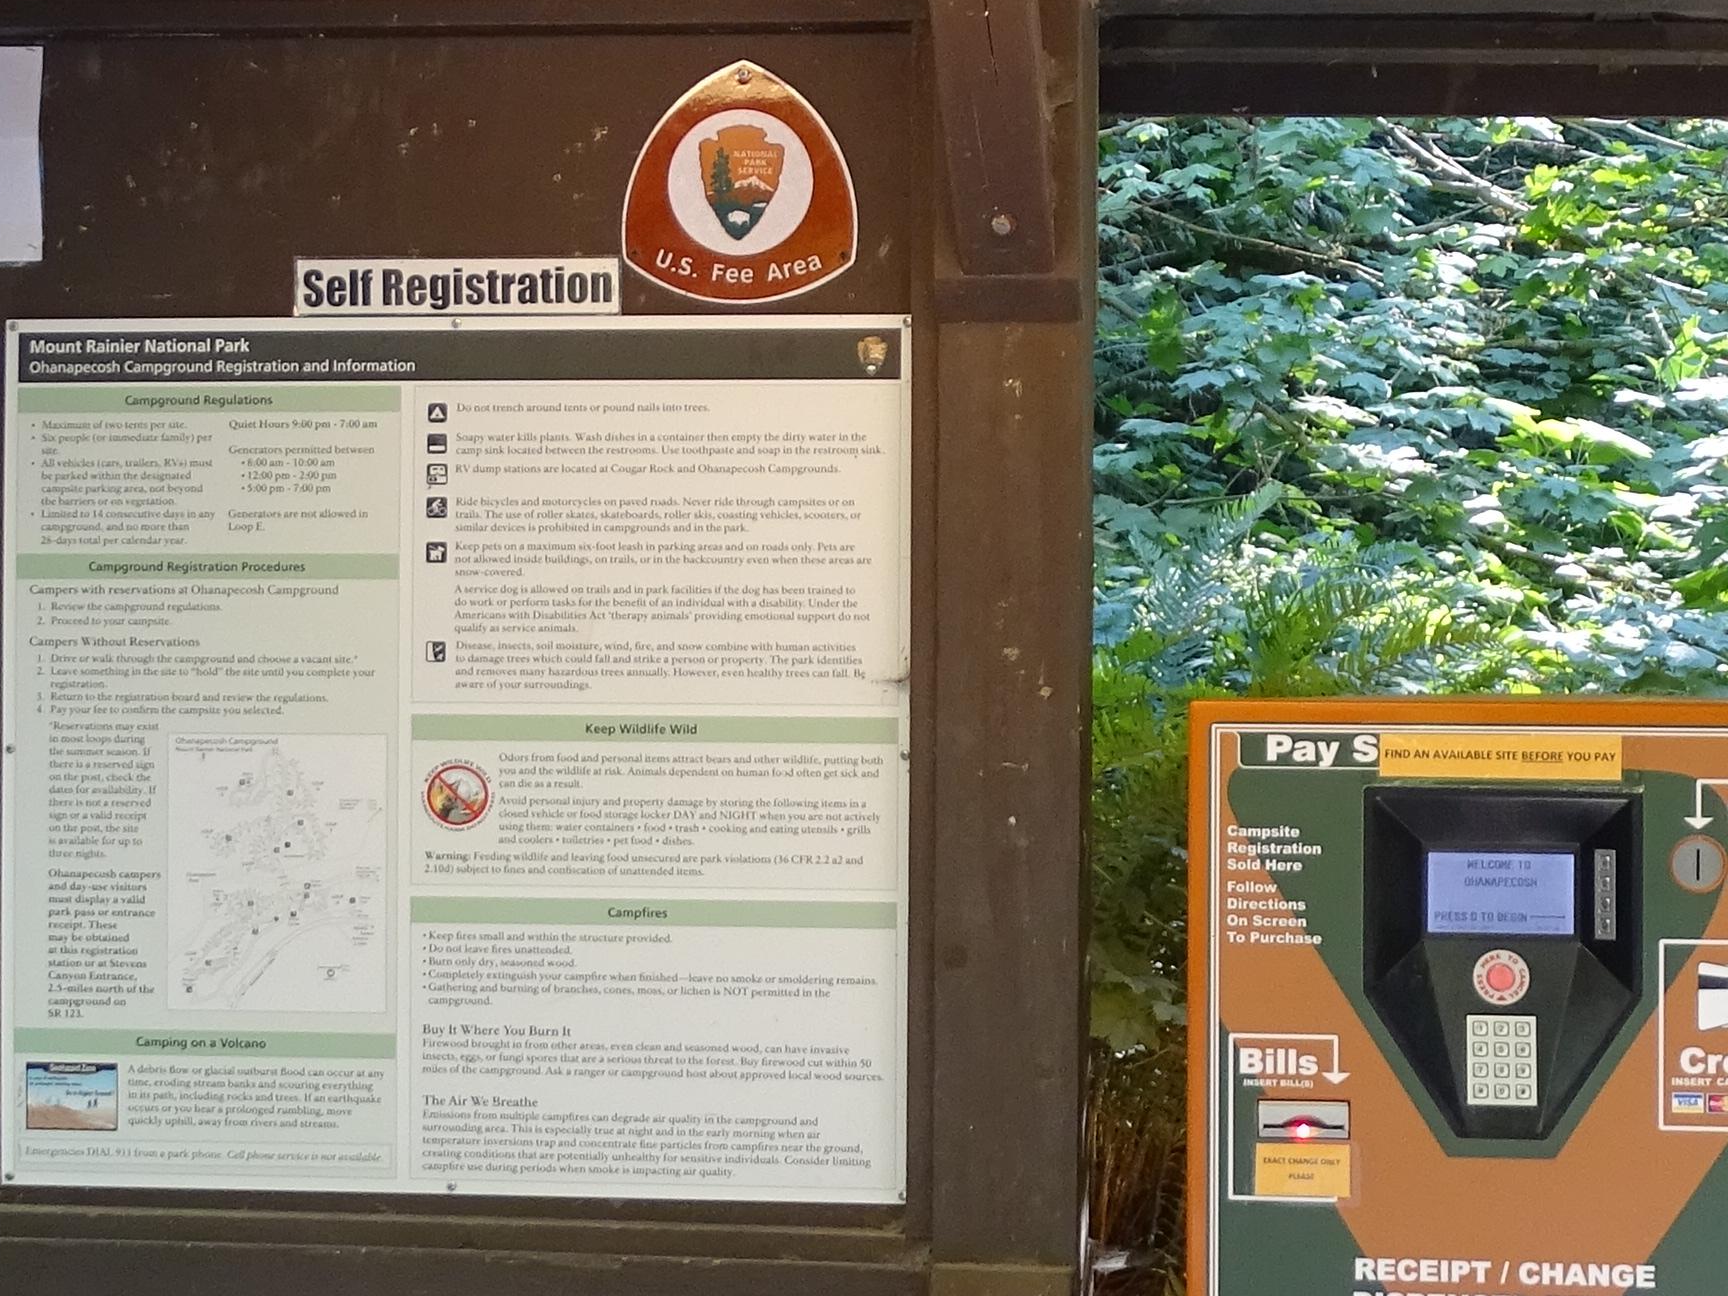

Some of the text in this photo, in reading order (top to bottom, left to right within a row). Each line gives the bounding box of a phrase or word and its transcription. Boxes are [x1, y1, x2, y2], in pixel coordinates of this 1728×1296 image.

[656, 249, 822, 283] U.S. Fee Area
[304, 267, 612, 310] Self Registration
[30, 338, 250, 354] Mount Rainier National Park
[29, 359, 415, 376] Ohanapecosh Campground Registration and Information
[125, 395, 273, 408] Campground Regulations
[89, 561, 306, 575] Campground Registration Procedures
[29, 584, 339, 598] Campers with reservations at Ohanapecosh Campground
[29, 636, 200, 649] Campers Without Reservations
[586, 723, 697, 736] Keep Wildlife Wild
[1267, 735, 1378, 767] Pay S
[1385, 749, 1616, 763] FIND AN AVAILABLE SITE BEFORE YOU PAY
[1228, 825, 1300, 840] Campsite
[1228, 842, 1322, 856] Registration
[1228, 859, 1303, 872] Sold Here
[1228, 881, 1277, 893] Follow
[1228, 898, 1306, 911] Directions
[608, 907, 668, 920] Campfires
[1227, 915, 1307, 928] On Screen
[1227, 932, 1322, 945] To Purchase
[423, 1024, 571, 1038] Buy It Where You Burn It
[136, 1037, 267, 1051] Camping on a Volcano
[1240, 1048, 1318, 1075] Bills
[1243, 1079, 1313, 1089] INSERT BILL(S)
[1672, 1078, 1712, 1086] INSERT
[423, 1095, 538, 1108] The Air We Breathe
[1355, 1258, 1492, 1284] RECEIPT
[1519, 1262, 1656, 1289] CHANGE
